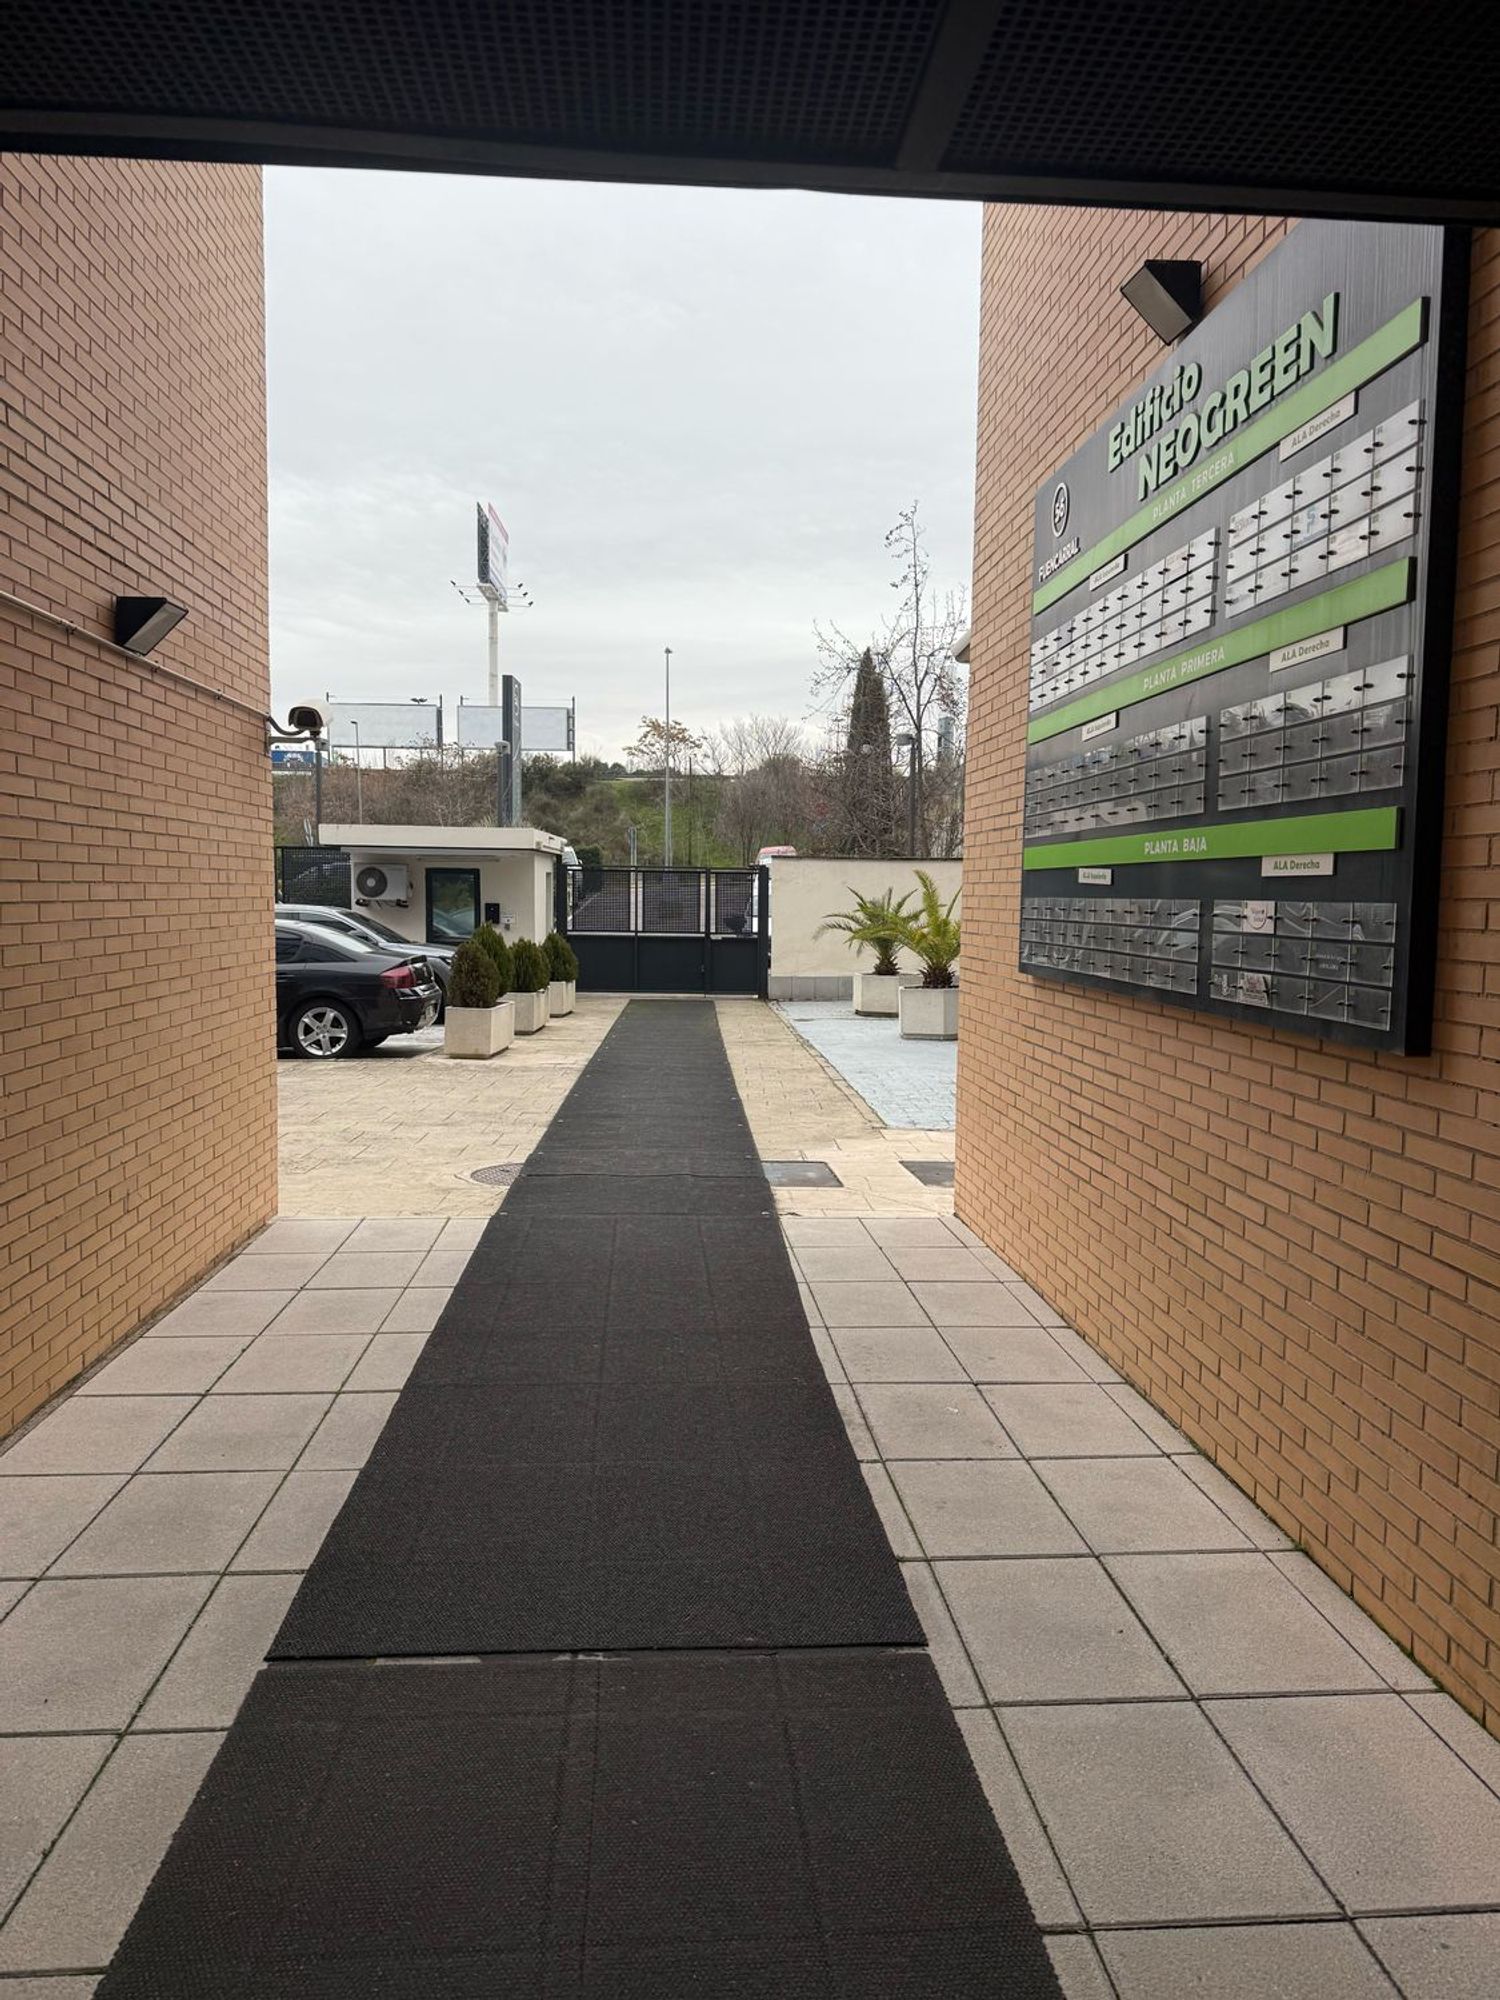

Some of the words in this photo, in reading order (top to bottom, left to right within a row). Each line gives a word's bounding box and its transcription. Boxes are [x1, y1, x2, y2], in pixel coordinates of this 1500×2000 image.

[1138, 292, 1339, 500] NEOGREEN
[1108, 363, 1201, 473] Edificio
[1291, 431, 1308, 448] ALA
[1308, 410, 1341, 436] Derecha
[1152, 487, 1187, 520] PLANTA
[1191, 452, 1235, 493] TERCERA
[1143, 665, 1177, 692] PLANTA
[1181, 646, 1225, 676] PRIMERA
[1281, 648, 1297, 662] ALA
[1298, 640, 1330, 656] Derecha
[1144, 839, 1179, 855] PLANTA
[1182, 836, 1207, 854] BAJA
[1273, 860, 1289, 871] ALA
[1289, 859, 1320, 870] Derecha
